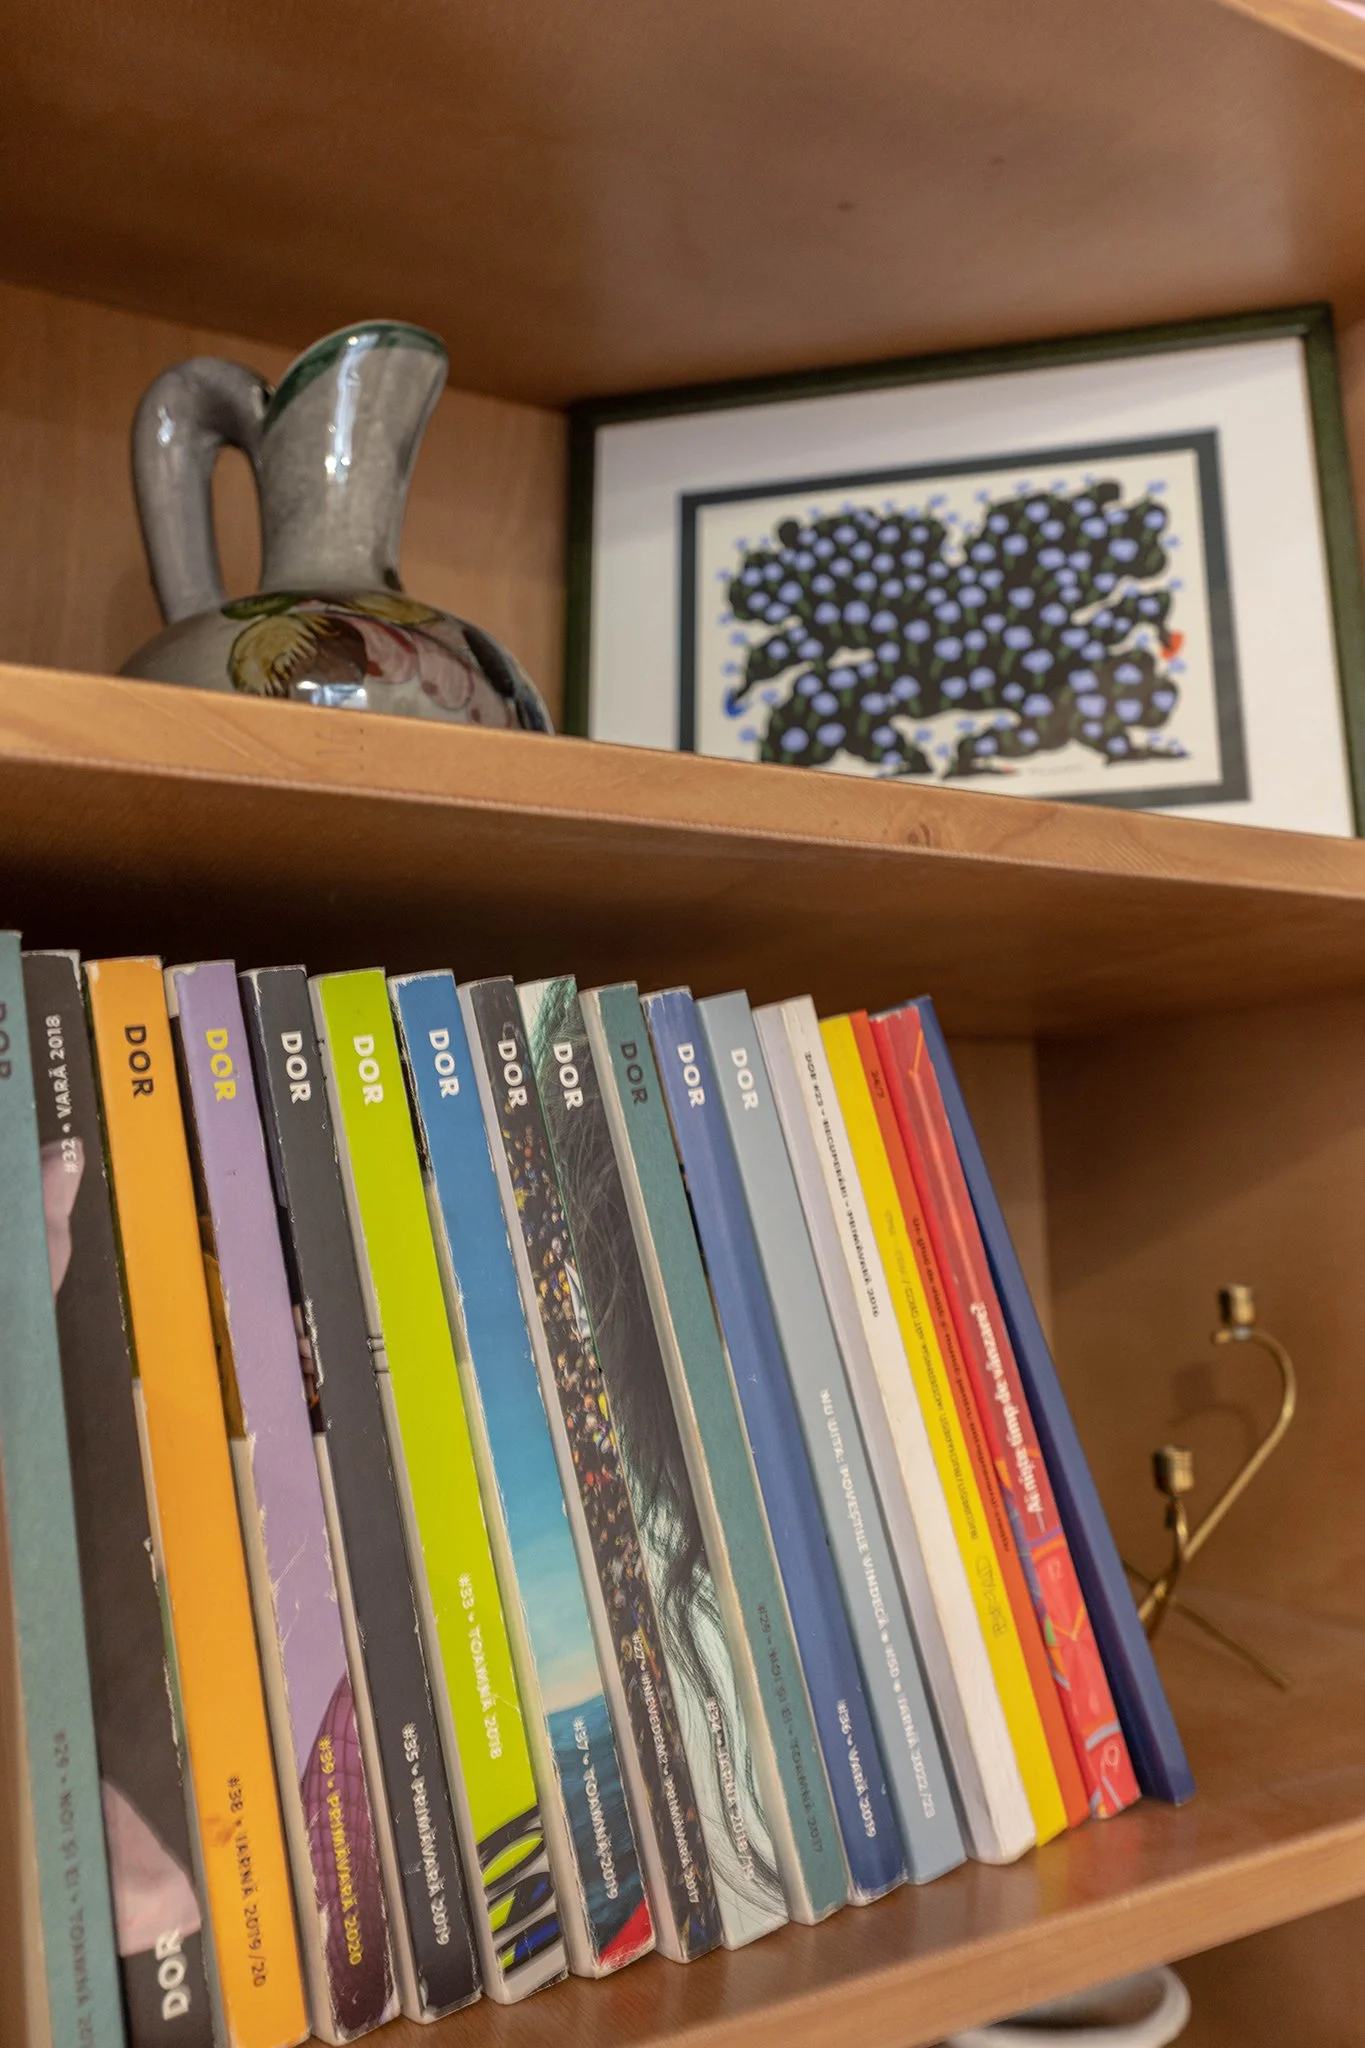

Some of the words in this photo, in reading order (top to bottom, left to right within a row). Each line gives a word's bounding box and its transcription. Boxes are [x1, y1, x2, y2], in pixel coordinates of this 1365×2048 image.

[46, 1015, 64, 1060] 2018
[123, 1024, 154, 1099] DOR
[205, 1028, 237, 1102] DOR
[280, 1030, 312, 1104] DOR
[353, 1034, 384, 1106] DOR
[429, 1028, 460, 1099] DOR
[48, 1064, 72, 1118] VARĂ
[498, 1038, 528, 1109] DOR
[553, 1042, 584, 1110] DOR
[621, 1041, 648, 1106] DOR
[677, 1043, 705, 1108] DOR
[731, 1048, 759, 1110] DOR
[62, 1140, 82, 1176] #32
[820, 1389, 834, 1416] NU
[460, 1574, 474, 1608] #33
[470, 1627, 496, 1711] TOAMNĂ
[484, 1716, 502, 1758] 2018
[704, 1696, 726, 1734] #34
[226, 1775, 244, 1813] #38
[631, 1630, 646, 1662] #27
[664, 1776, 692, 1869] PRIMĂVARĂ
[682, 1868, 699, 1902] 2017
[837, 1700, 852, 1734] #36
[848, 1744, 868, 1796] VARĂ
[859, 1796, 876, 1838] 2019
[402, 1724, 419, 1762] #35
[412, 1778, 444, 1896] PRIMĂVARĂ
[430, 1896, 450, 1945] 2019
[574, 1718, 592, 1752] #37
[584, 1766, 610, 1854] TOAMNĂ
[600, 1856, 618, 1900] 2019
[234, 1834, 258, 1898] IARNĂ
[320, 1738, 334, 1774] #39
[328, 1792, 356, 1910] PRIMĂVARĂ
[344, 1913, 362, 1964] 2020
[155, 1928, 189, 2020] DOR
[242, 1904, 268, 1988] 2019/20
